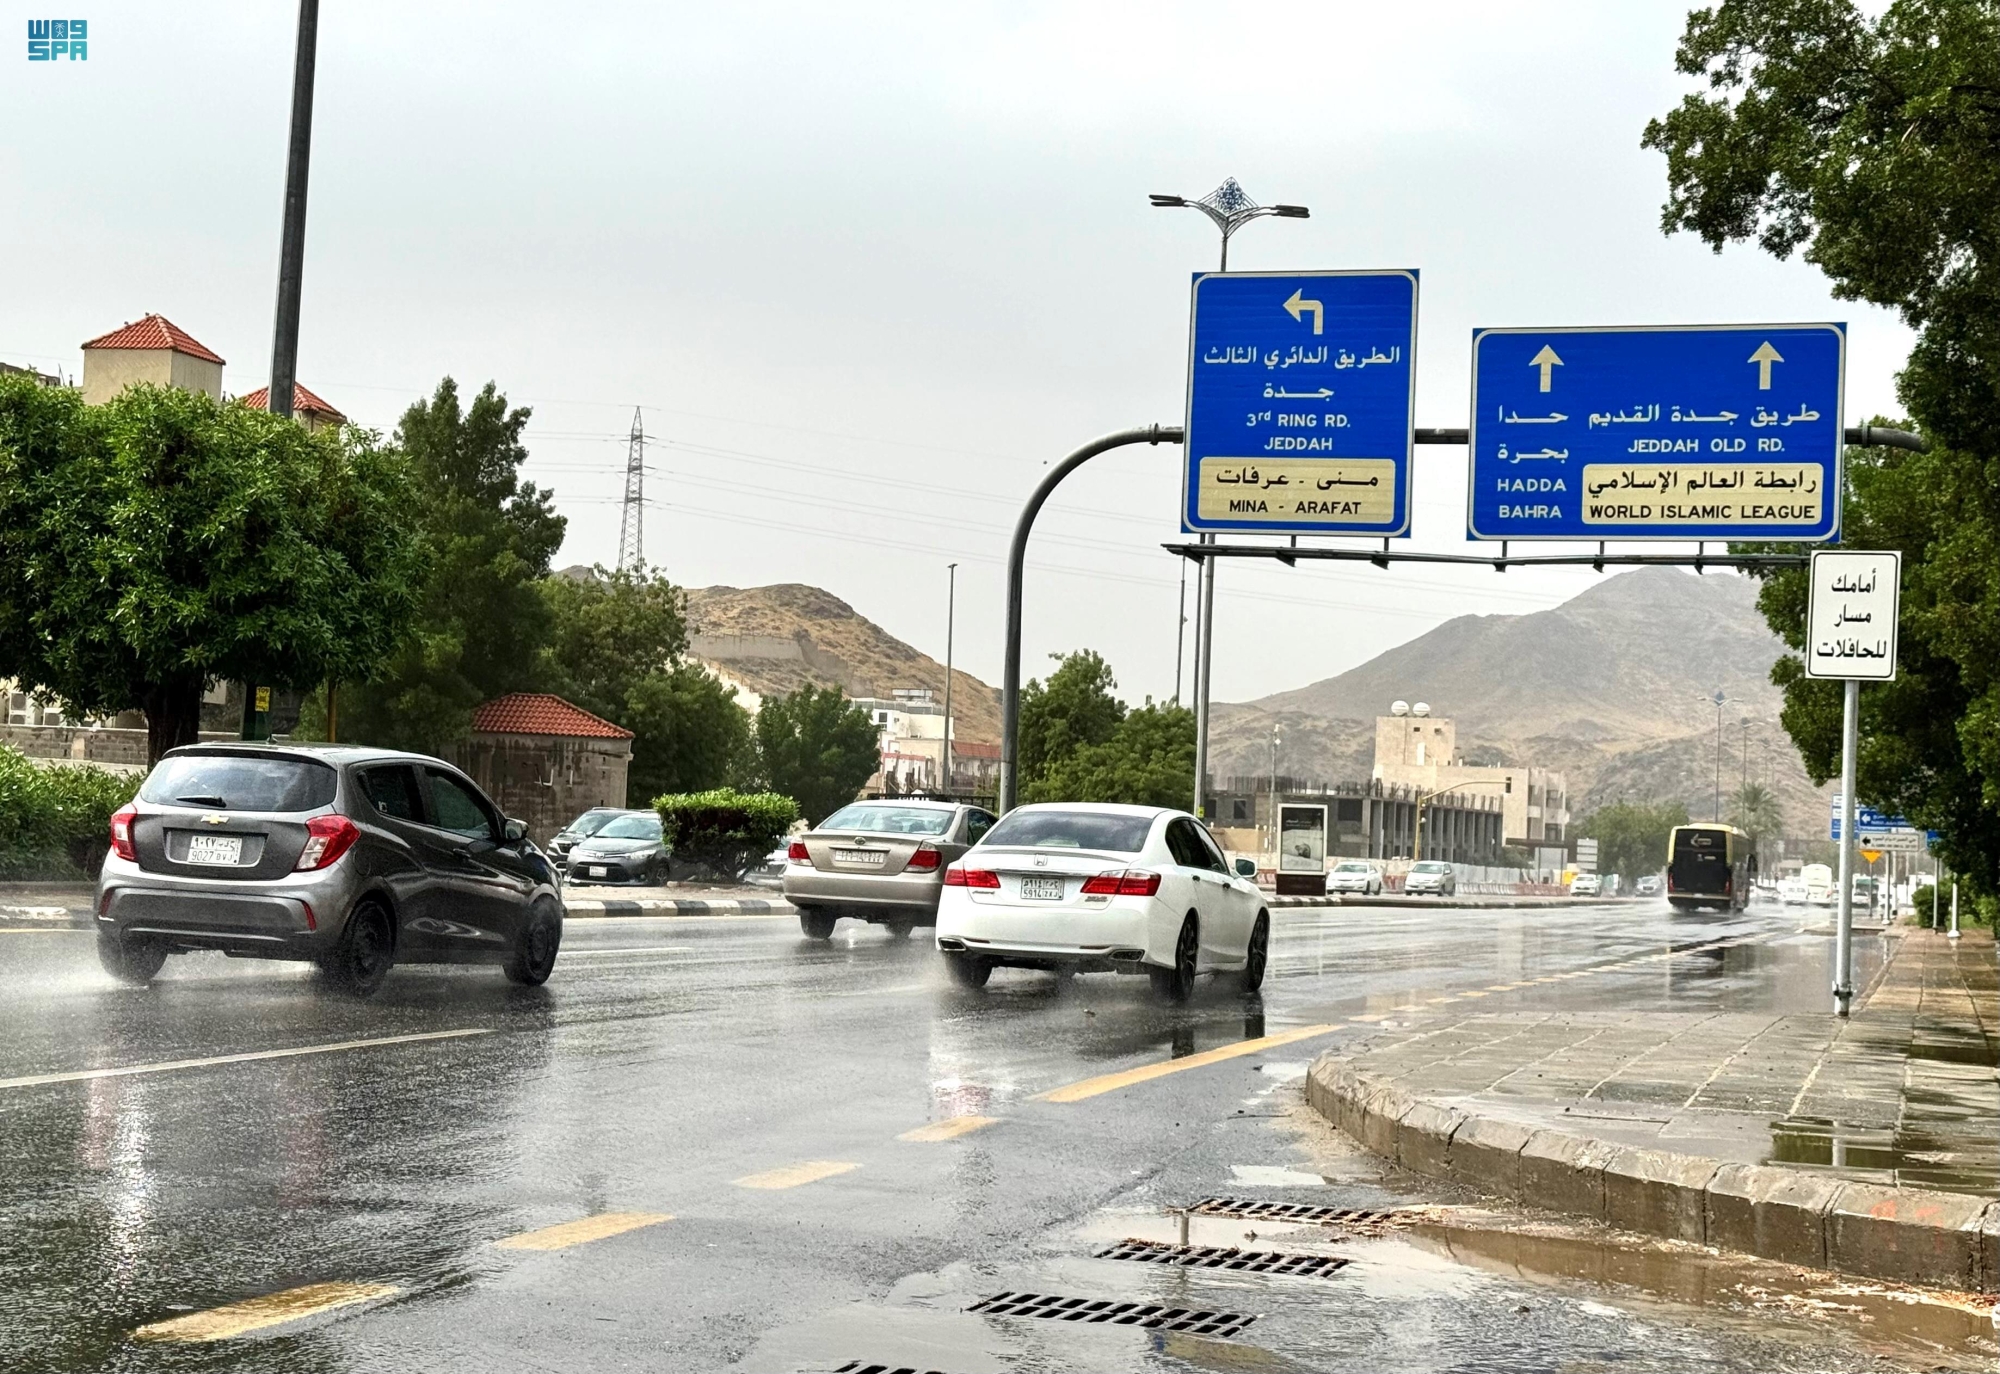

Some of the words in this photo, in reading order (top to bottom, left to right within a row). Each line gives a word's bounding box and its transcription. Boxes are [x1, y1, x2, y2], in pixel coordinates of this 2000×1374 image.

[1203, 346, 1257, 364] الثالث
[1264, 345, 1328, 369] الدائري
[1334, 345, 1400, 369] الطريق
[1263, 383, 1335, 402] جدة
[1246, 410, 1271, 427] 3rd
[1277, 414, 1317, 427] RING
[1324, 414, 1351, 428] RD.
[1498, 404, 1569, 423] حدا
[1588, 403, 1660, 430] القديم
[1671, 405, 1740, 426] جدة
[1750, 403, 1821, 428] طريق
[1264, 437, 1333, 451] JEDDAH
[1497, 443, 1569, 464] بحرة
[1627, 438, 1699, 453] JEDDAH
[1710, 438, 1746, 452] OLD
[1758, 438, 1785, 452] RD.
[1216, 466, 1290, 490] عرفات
[1316, 471, 1379, 490] منى
[1497, 478, 1567, 492] HADDA
[1588, 470, 1678, 498] الإسلامي
[1687, 470, 1744, 495] العالم
[1754, 470, 1817, 493] رابطة
[1229, 500, 1269, 513] MINA
[1295, 501, 1362, 515] ARAFAT
[1498, 505, 1562, 519] BAHRA
[1590, 505, 1652, 519] WORLD
[1660, 505, 1732, 519] ISLAMIC
[1741, 505, 1815, 519] LEAGUE
[1831, 568, 1877, 593] أمامك
[1834, 604, 1872, 627] مسار
[1816, 638, 1887, 659] للحافلات
[191, 850, 214, 861] 9027
[1023, 889, 1041, 898] 5914
